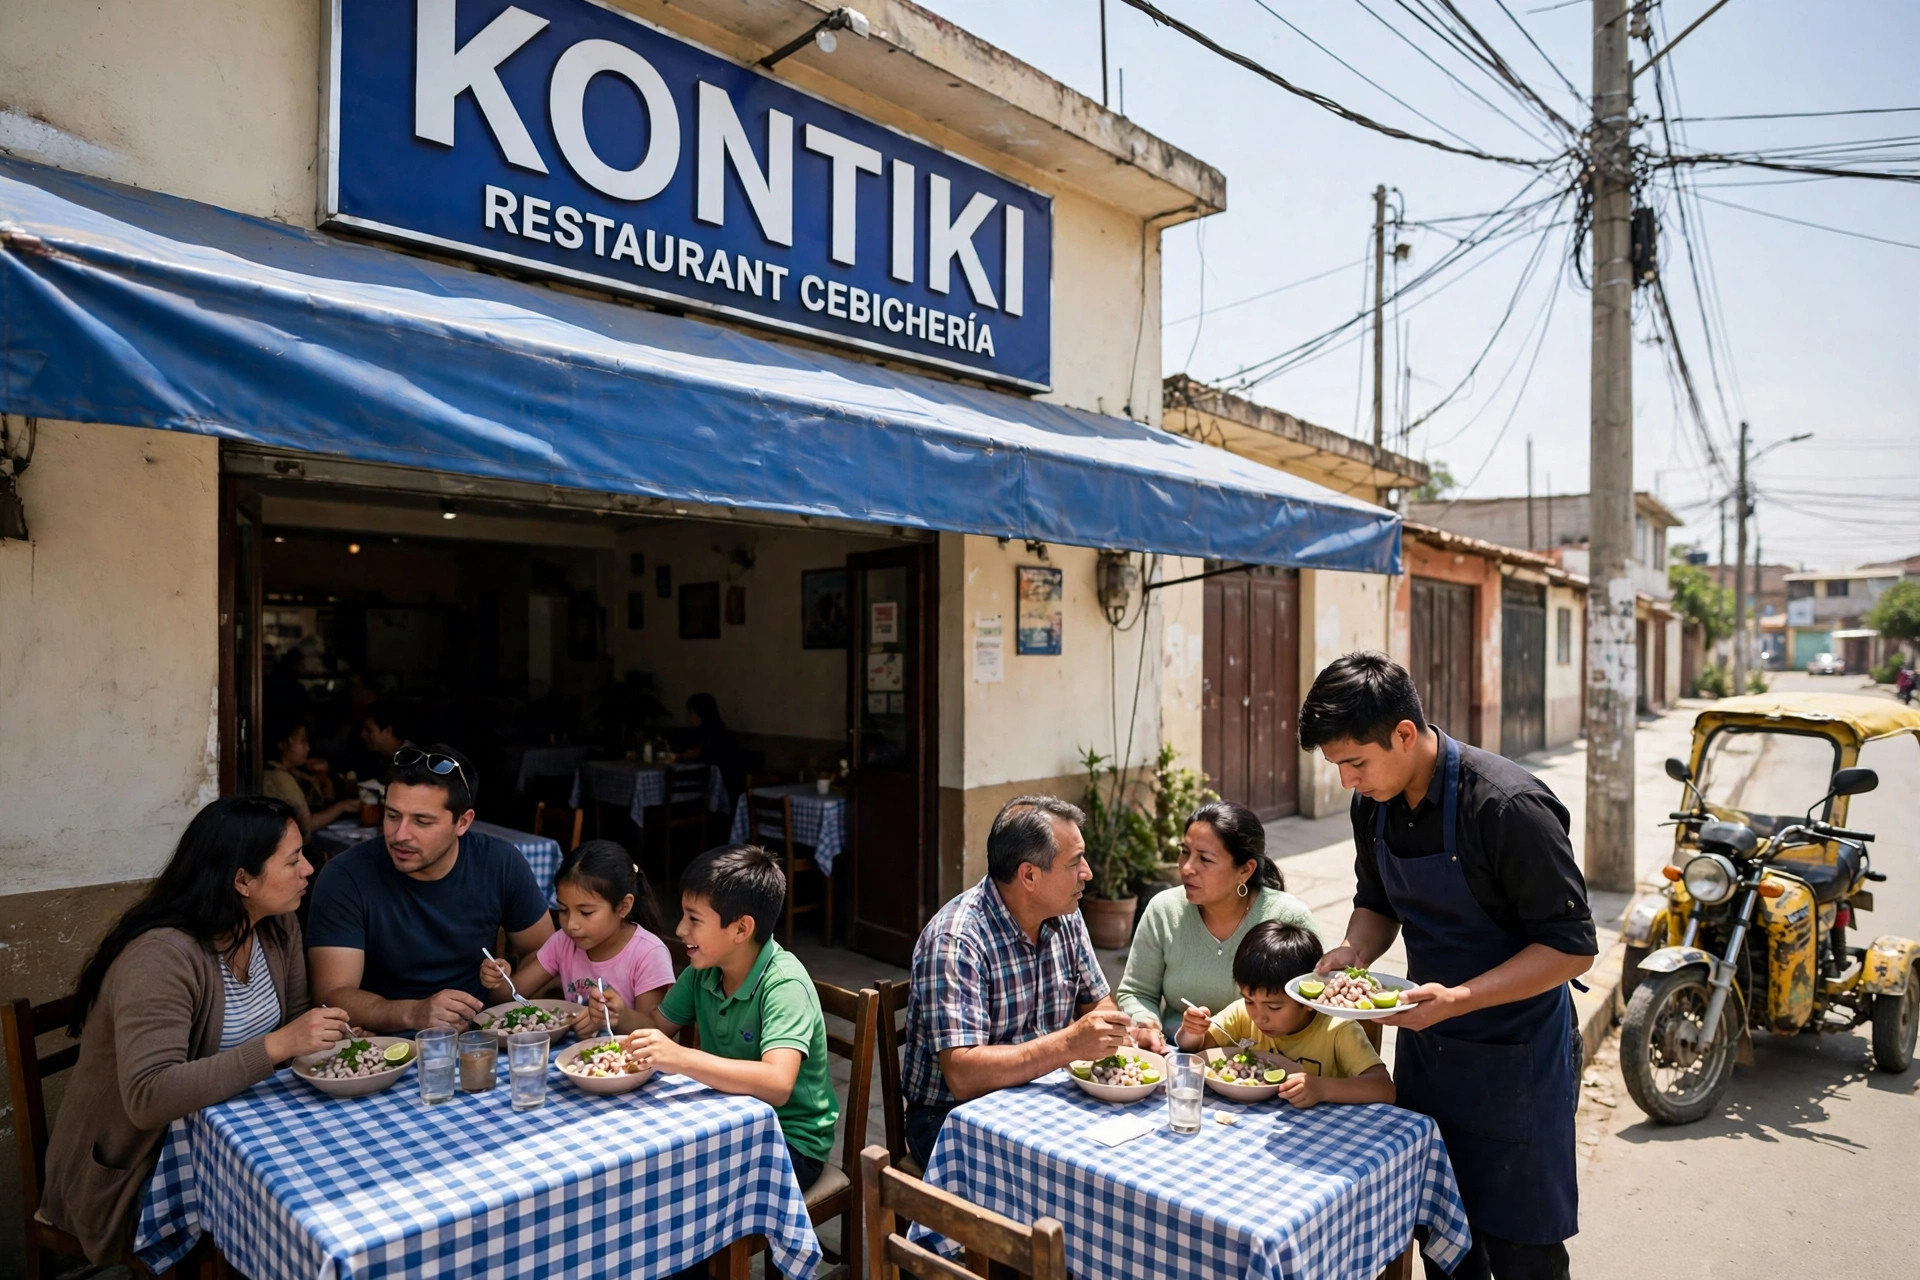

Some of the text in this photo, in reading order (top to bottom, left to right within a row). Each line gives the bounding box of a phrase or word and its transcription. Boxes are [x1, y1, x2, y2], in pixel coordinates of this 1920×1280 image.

[415, 0, 1025, 318] KONTIKI
[484, 184, 996, 359] RESTAURANT CEBICHERÍA
